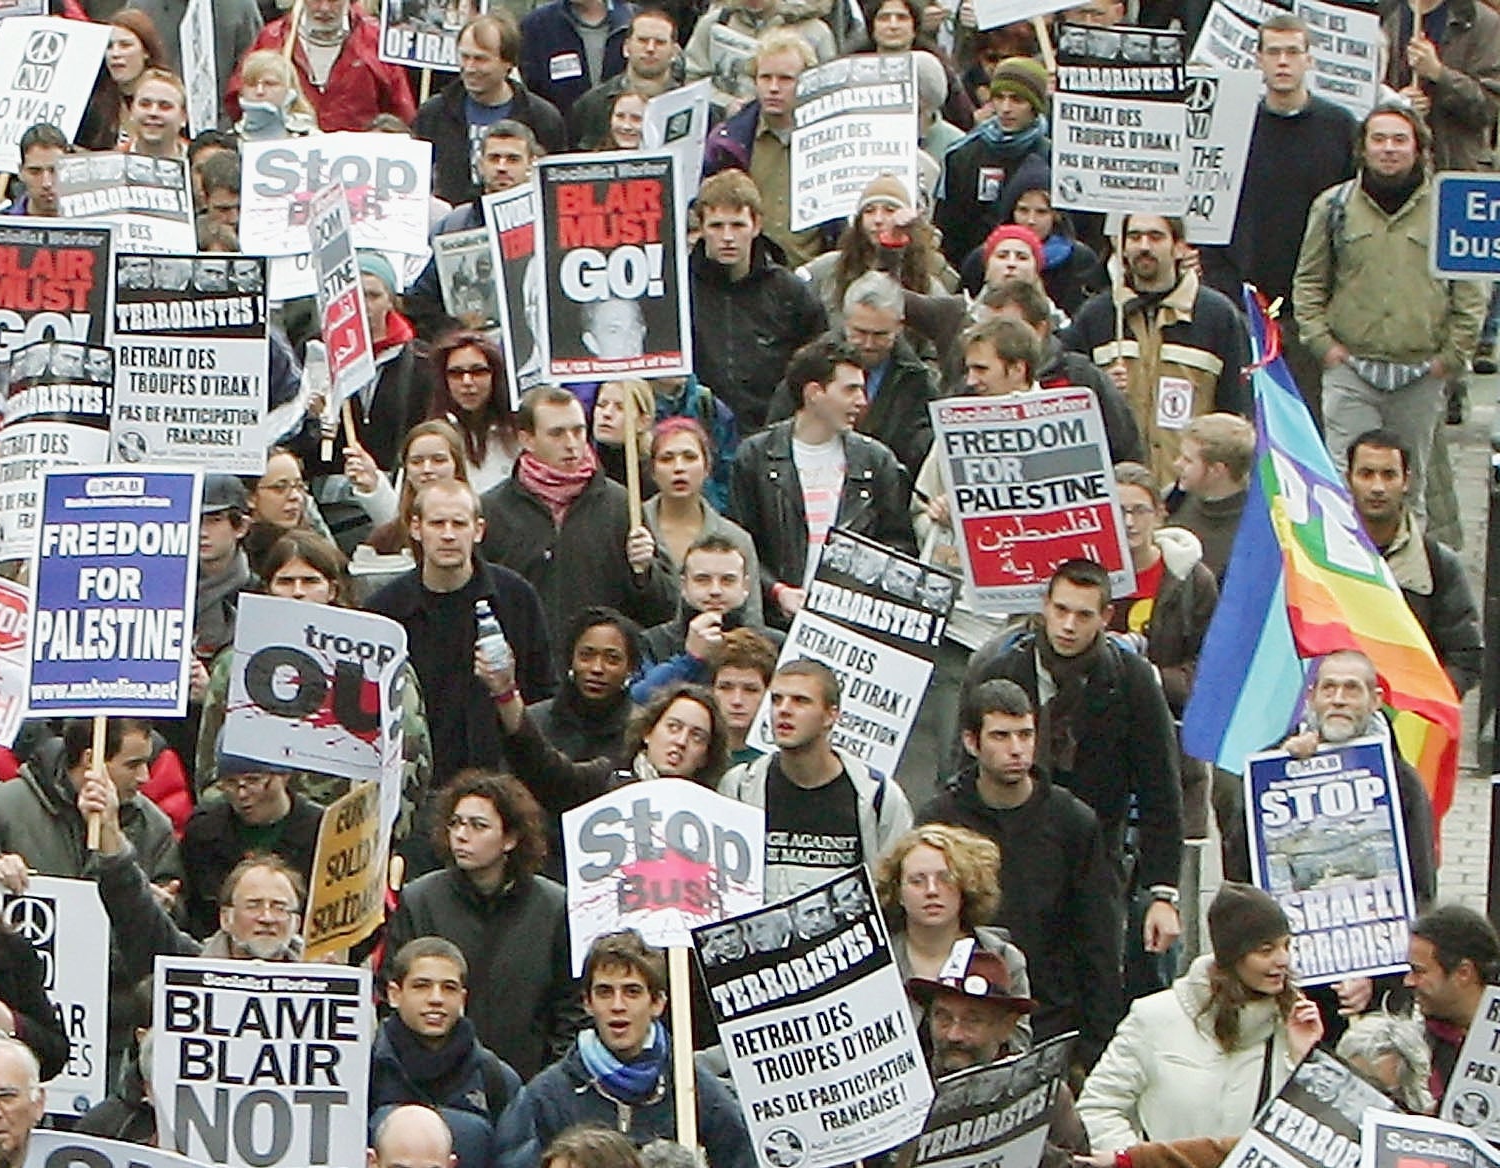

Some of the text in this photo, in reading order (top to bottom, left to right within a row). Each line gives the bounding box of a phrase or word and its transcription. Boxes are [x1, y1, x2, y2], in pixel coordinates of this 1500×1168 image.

[385, 31, 460, 65] OF IRA
[1058, 66, 1173, 92] TERRORISTES
[19, 100, 66, 126] WAR
[1060, 103, 1142, 127] RETRAIT DES
[253, 148, 418, 201] Stop
[1191, 146, 1225, 168] THE
[557, 180, 662, 213] BLAIR
[558, 213, 662, 248] MUST
[560, 243, 664, 303] GO!
[117, 300, 256, 332] TERRORISTES
[120, 346, 216, 368] RETRAIT DES
[945, 418, 1088, 456] FREEDOM
[964, 457, 1024, 483] FOR
[956, 475, 1109, 513] PALESTINE
[42, 522, 189, 558] FREEDOM
[78, 567, 142, 601] FOR
[34, 609, 183, 662] PALESTINE
[1259, 776, 1386, 828] STOP
[578, 797, 752, 886] Stop
[788, 833, 860, 852] AGAINST
[713, 933, 871, 1017] TERRORISTES
[164, 990, 361, 1042] BLAME
[732, 1001, 854, 1059] RETRAIT DES
[178, 1037, 341, 1086] BLAIR
[752, 1026, 900, 1085] TROUPES D'IRAK
[173, 1085, 349, 1168] NOT
